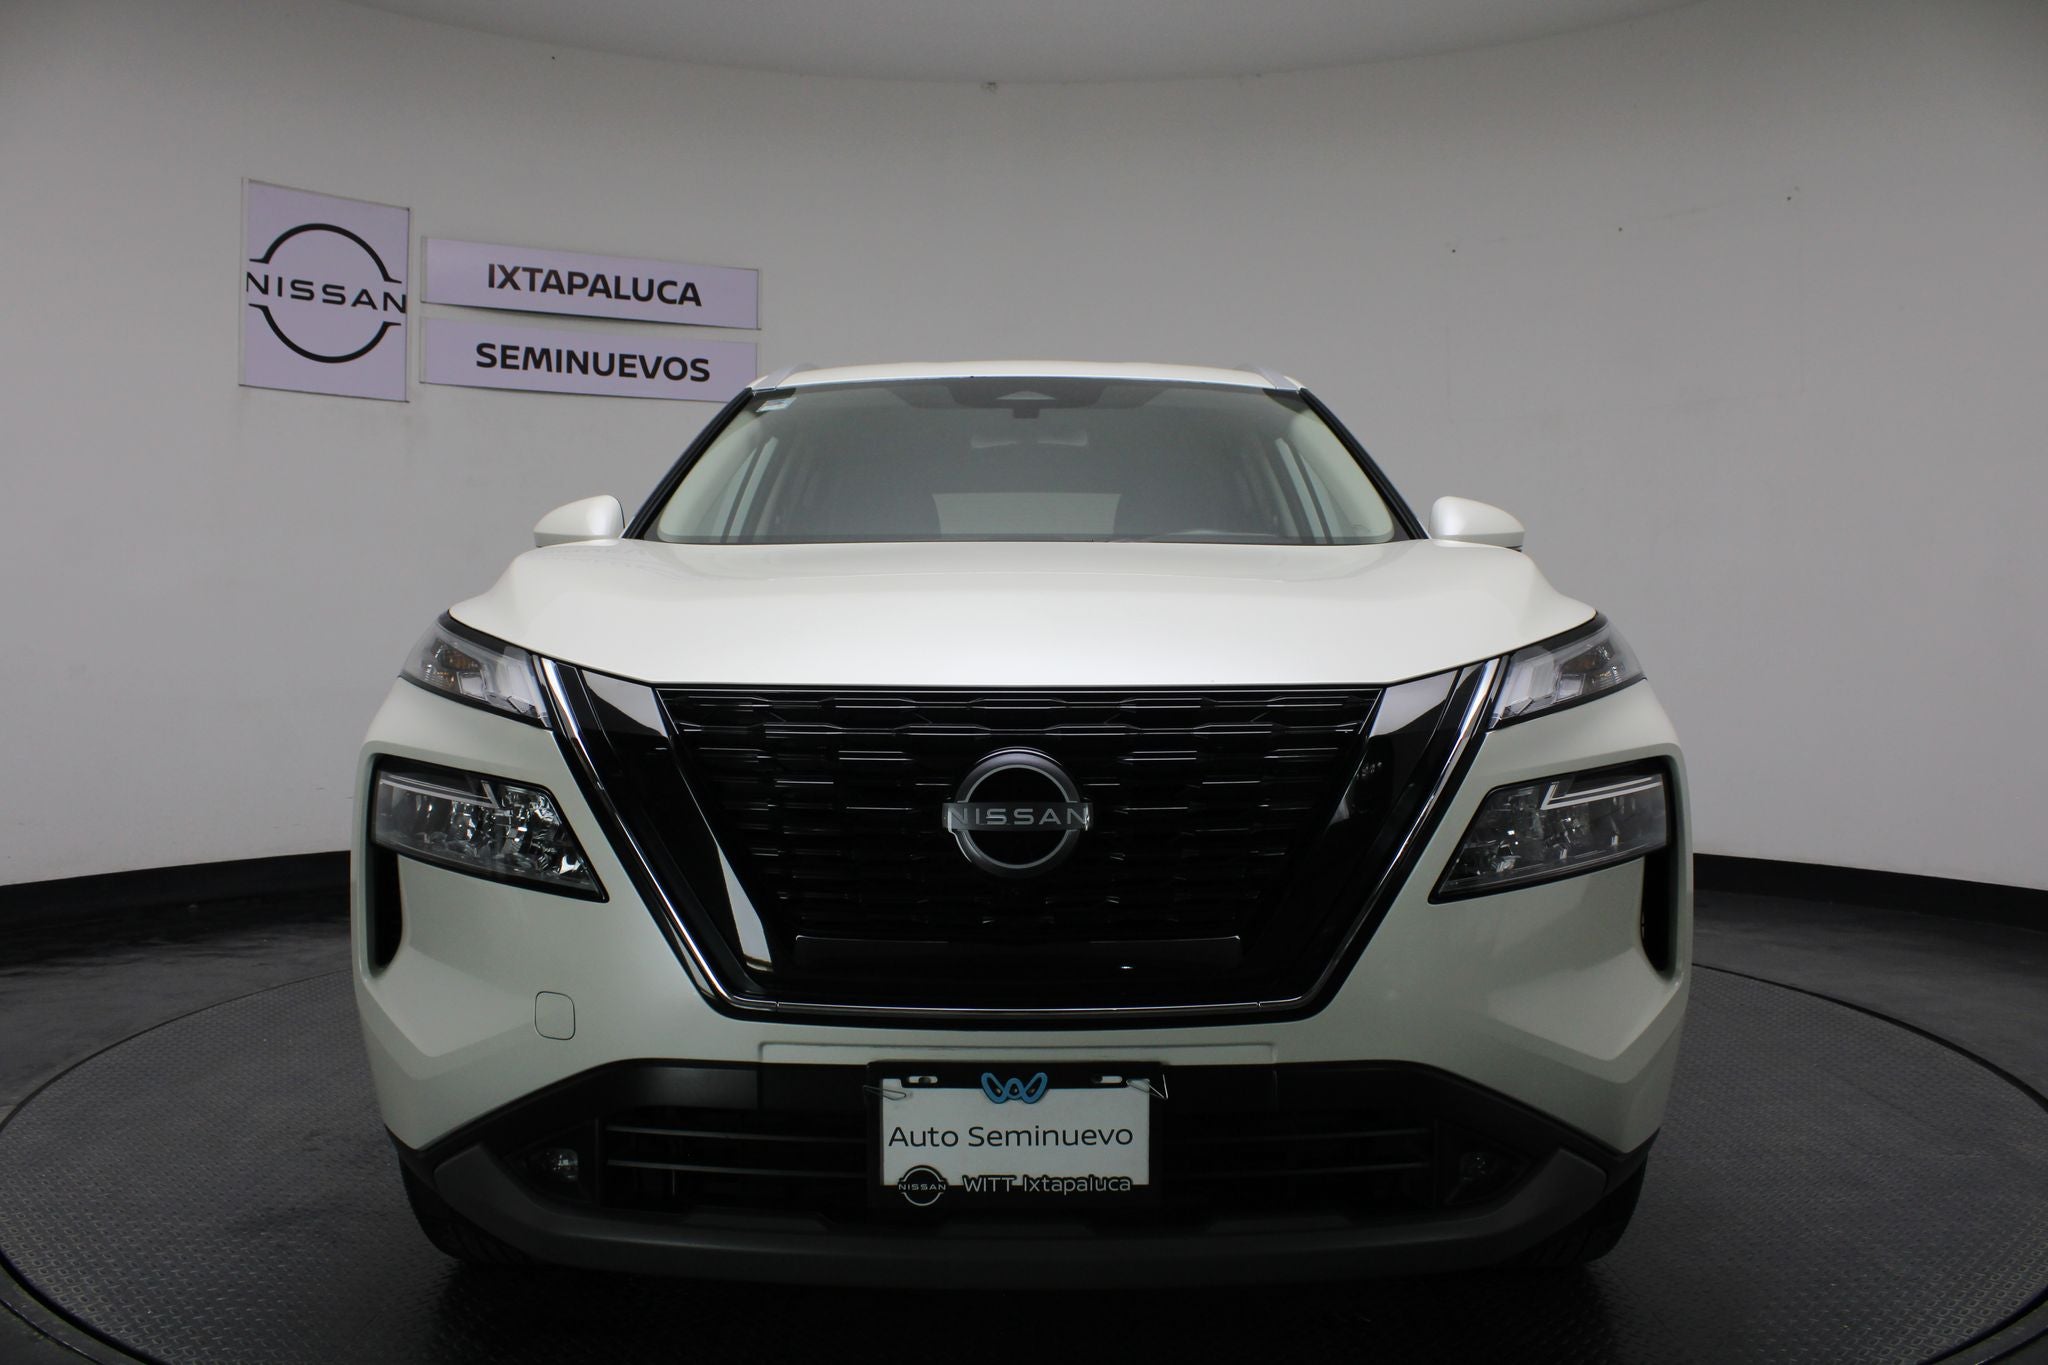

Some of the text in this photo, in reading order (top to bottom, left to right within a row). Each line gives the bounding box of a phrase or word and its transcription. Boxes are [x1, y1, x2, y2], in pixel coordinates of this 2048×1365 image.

[246, 271, 407, 314] NISSAN
[487, 263, 702, 307] IXTAPALUCA
[476, 342, 710, 382] SEMINUEVOS
[947, 807, 1088, 825] NISSAN
[888, 1125, 1133, 1148] Auto Seminuevo
[898, 1183, 947, 1191] NISSAN
[962, 1174, 1132, 1196] WITT Ixtapaluca
